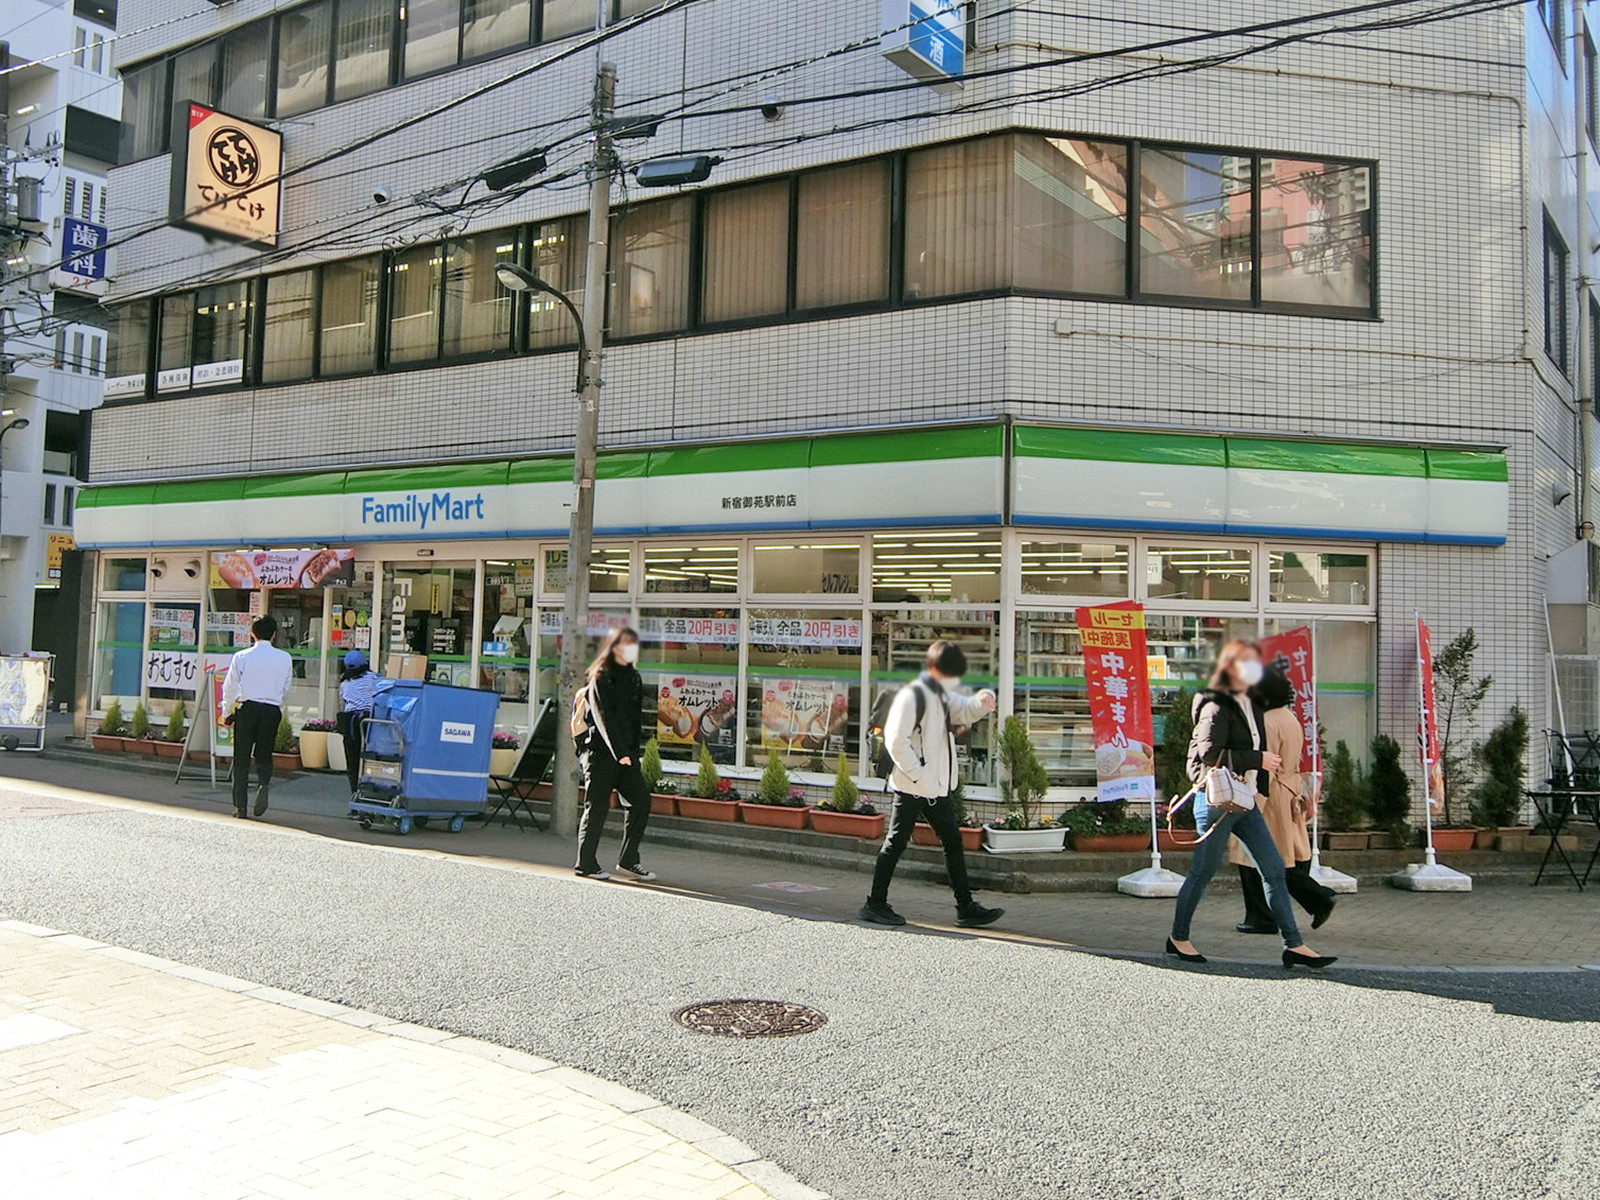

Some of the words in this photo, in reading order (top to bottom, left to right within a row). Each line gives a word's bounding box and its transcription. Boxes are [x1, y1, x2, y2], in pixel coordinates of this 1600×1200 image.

[69, 224, 99, 275] 歯科
[721, 494, 797, 510] 新宿御苑駅前店
[362, 492, 484, 529] FamilyMart
[259, 573, 295, 586] オムレット
[147, 652, 198, 685] おむすび
[678, 695, 719, 708] オムレット
[444, 727, 472, 737] SAGAWA
